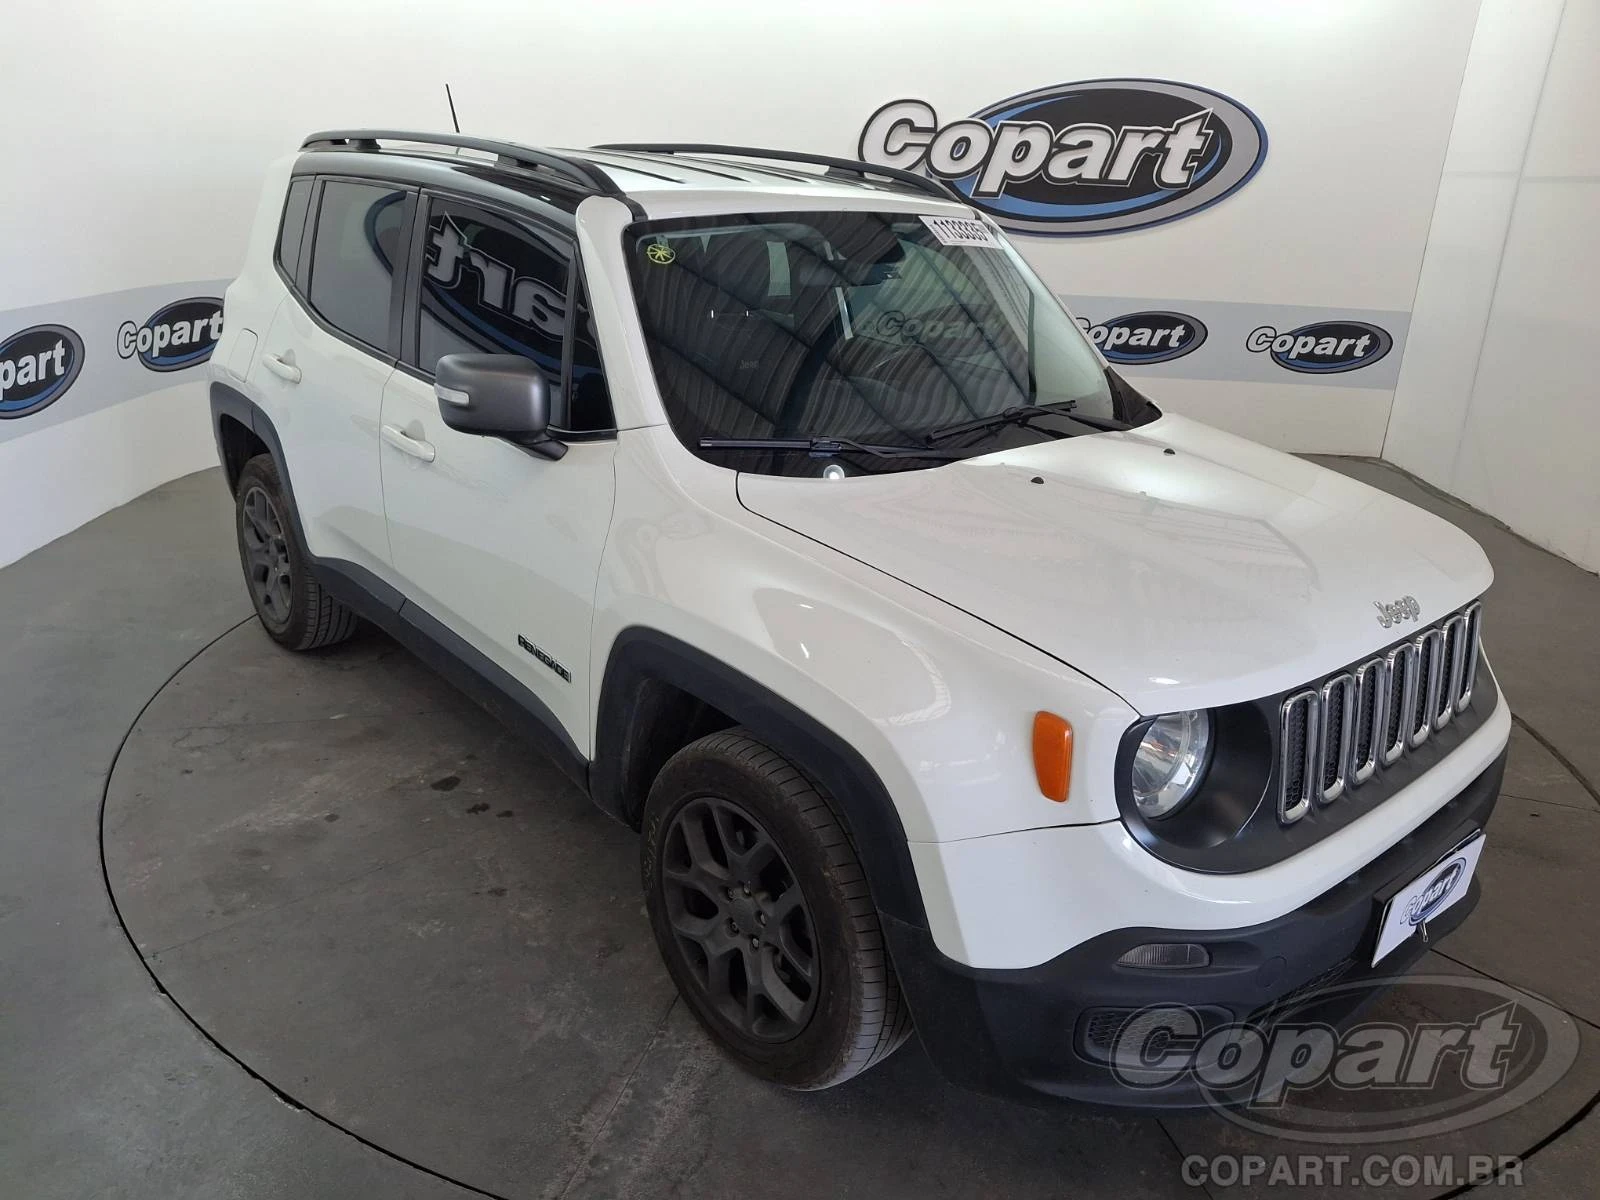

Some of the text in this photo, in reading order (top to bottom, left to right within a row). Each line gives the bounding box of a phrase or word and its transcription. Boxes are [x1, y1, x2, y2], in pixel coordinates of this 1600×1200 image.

[858, 99, 1214, 199] Copart
[116, 310, 224, 359] Copart
[1246, 326, 1371, 359] Copart
[1373, 596, 1421, 628] Jeep
[518, 633, 571, 683] RENEGADE
[1400, 866, 1460, 924] Copart
